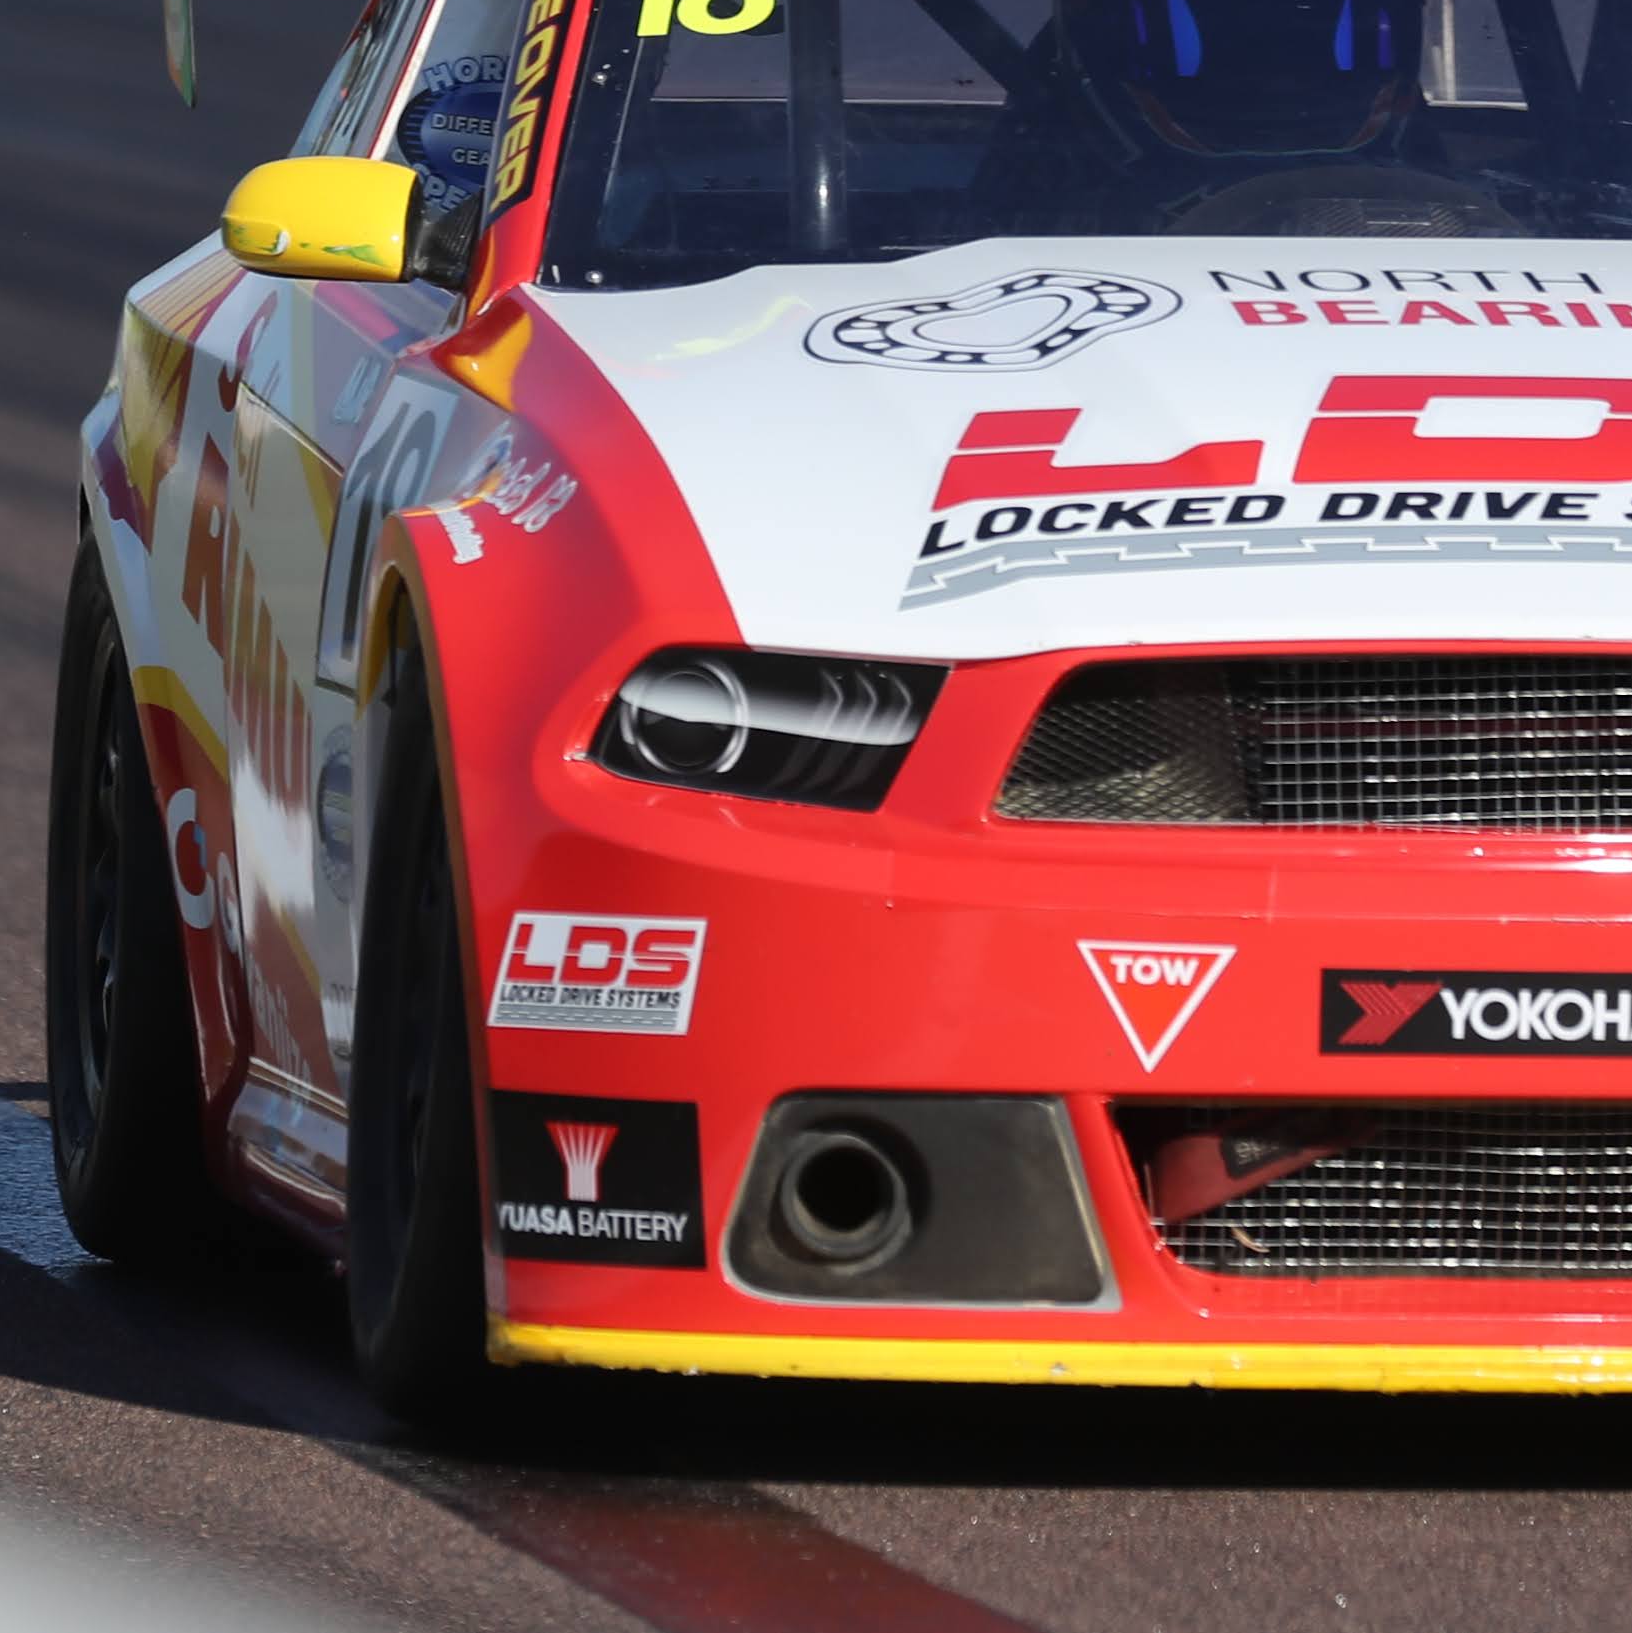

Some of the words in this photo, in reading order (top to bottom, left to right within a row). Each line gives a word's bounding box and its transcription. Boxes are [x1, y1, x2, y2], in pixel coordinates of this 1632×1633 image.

[1208, 268, 1603, 296] NORTH
[918, 494, 1287, 558] LOCKED
[1319, 491, 1601, 525] DRIVE
[504, 923, 697, 989] LDS
[1109, 954, 1199, 986] TOW
[500, 983, 556, 1004] LOCKED
[559, 986, 602, 1006] DRIVE
[605, 989, 681, 1009] SYSTEMS
[497, 1201, 575, 1236] YUASA
[578, 1208, 689, 1242] BATTERY
